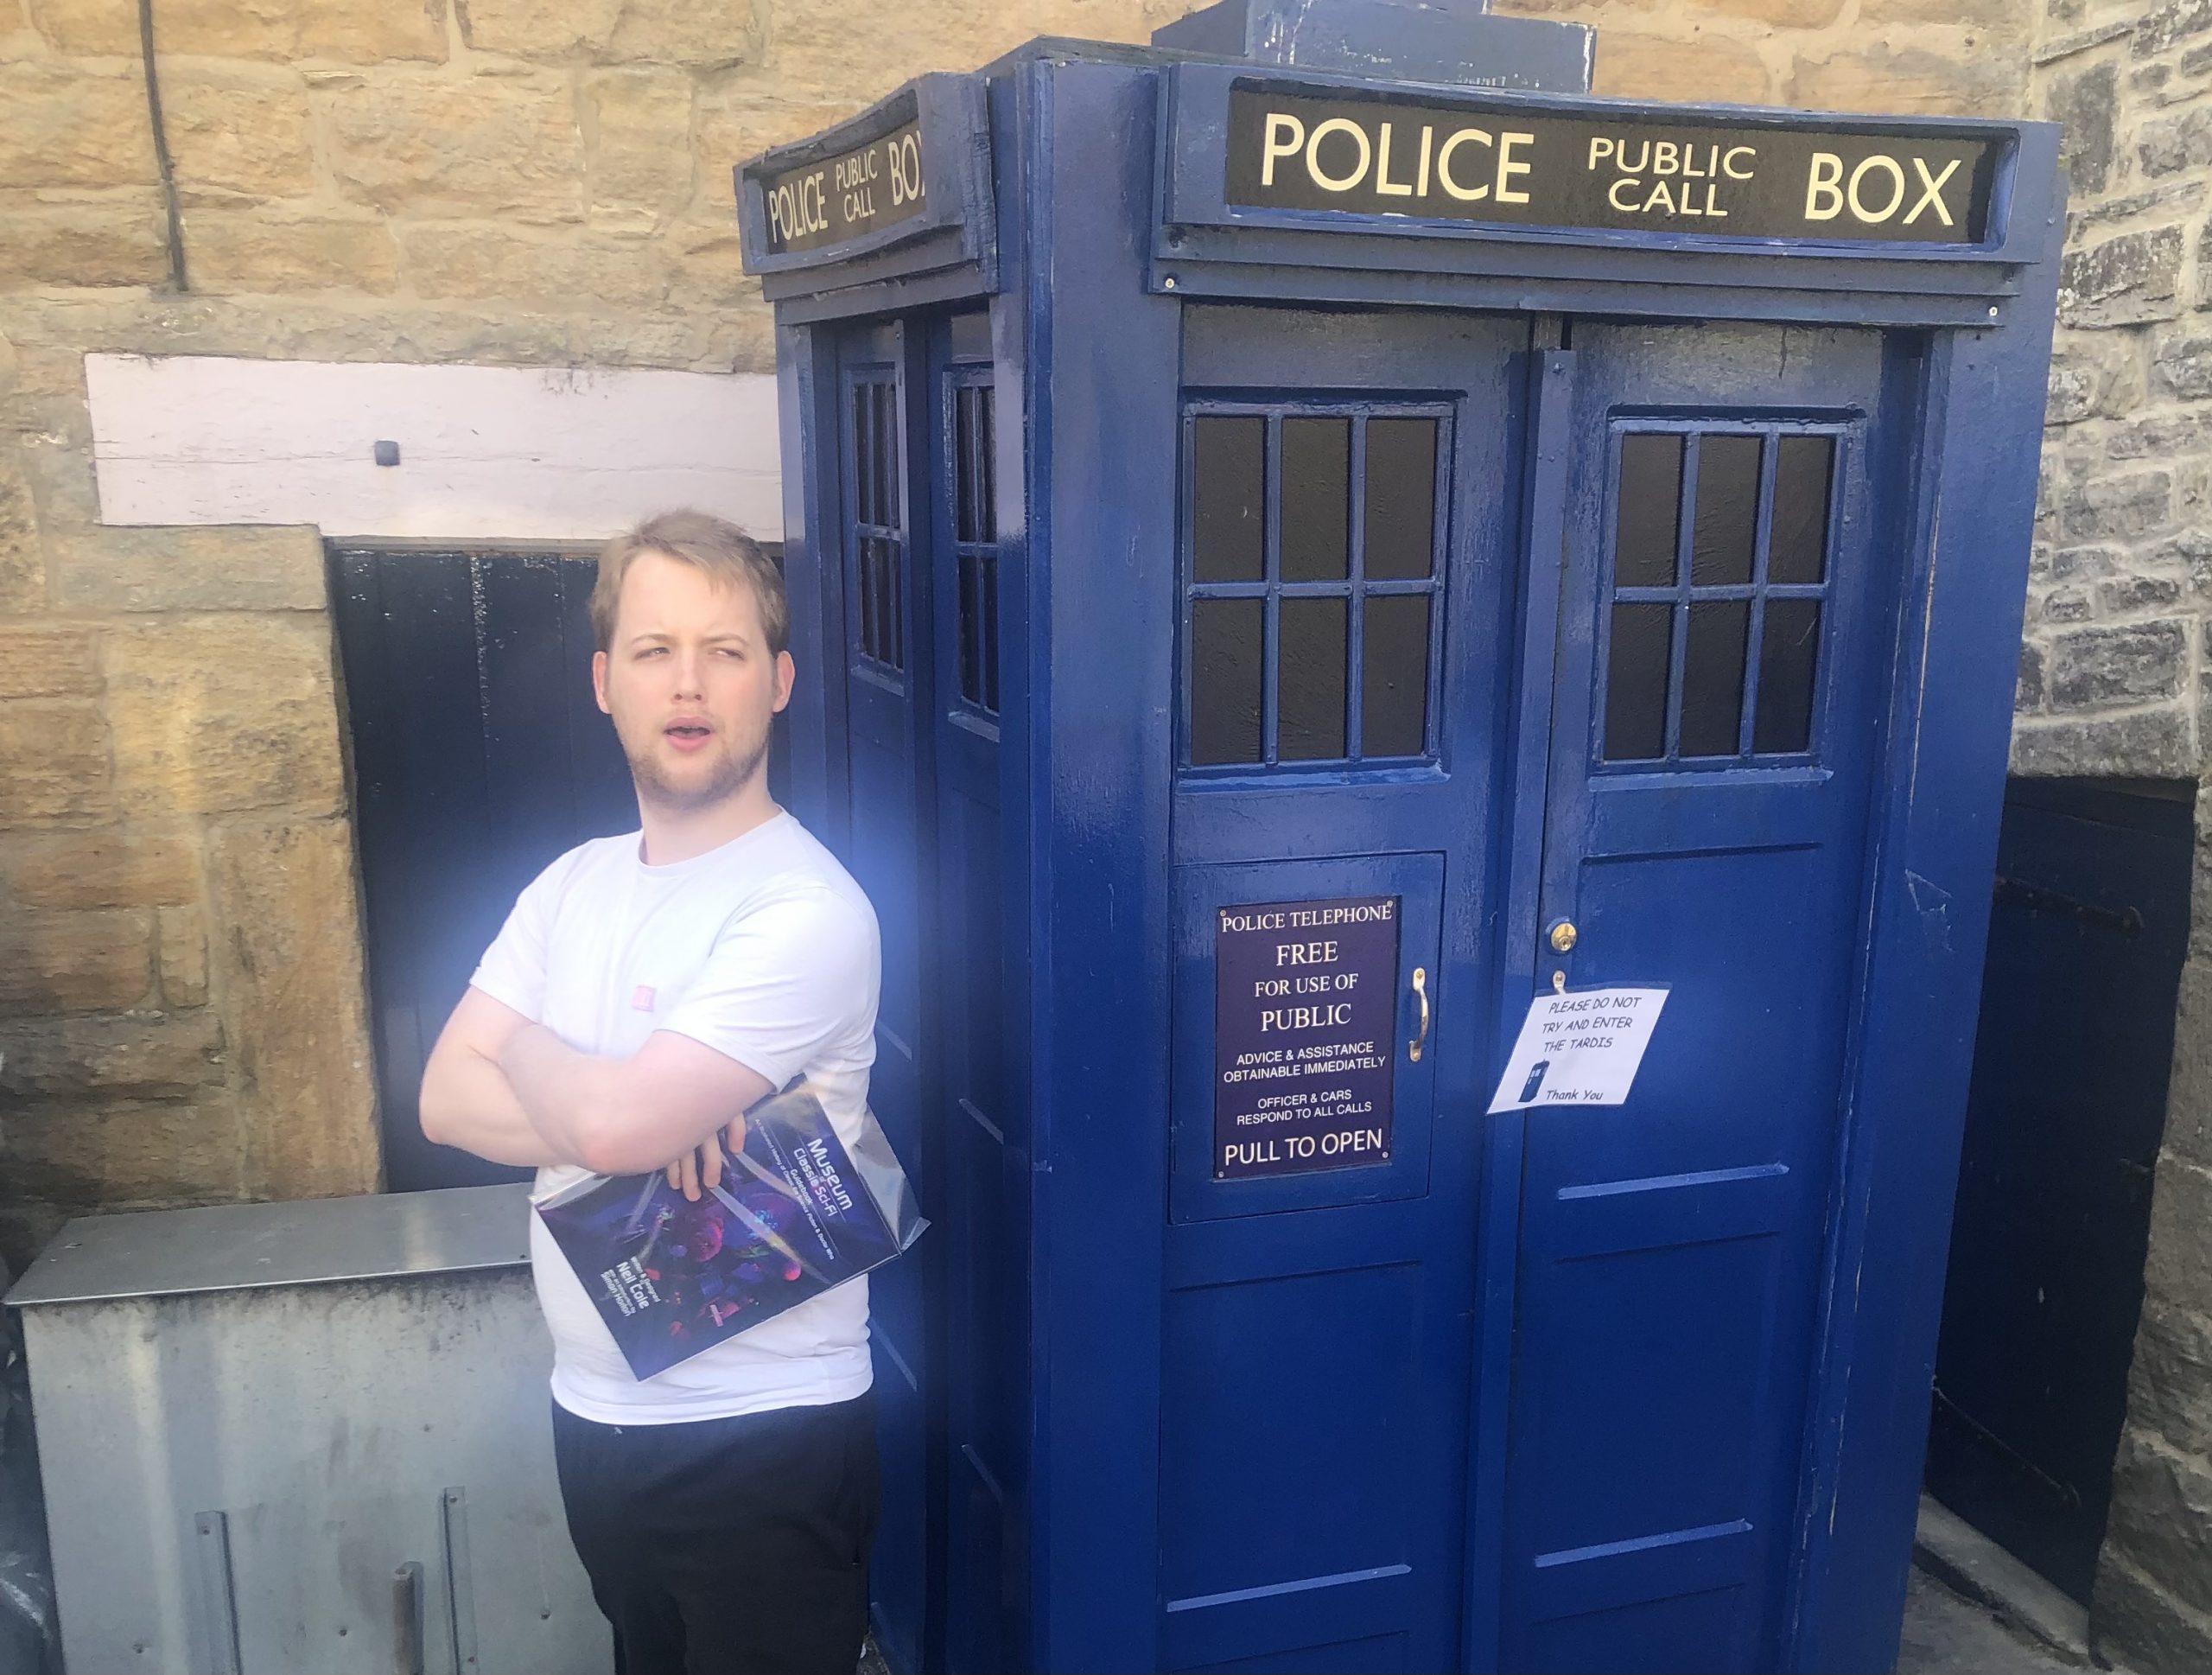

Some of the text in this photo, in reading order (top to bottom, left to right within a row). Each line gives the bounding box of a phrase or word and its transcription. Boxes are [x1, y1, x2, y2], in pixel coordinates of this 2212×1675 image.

[836, 149, 877, 191] PUBLIC
[1262, 113, 1534, 203] POLICE
[1588, 137, 1757, 180] PUBLIC
[1609, 178, 1729, 217] CALL
[1806, 152, 1961, 226] BOX
[769, 172, 828, 243] POLICE
[844, 188, 875, 222] CALL
[1222, 905, 1392, 933] POLICE TELEPHONE
[1276, 941, 1338, 966] FREE
[1255, 973, 1358, 997] FOR USE OF
[1262, 1003, 1351, 1031] PUBLIC
[1548, 997, 1642, 1014] PLEASE DO NOT
[1542, 1017, 1632, 1034] TRY AND ENTER
[1236, 1041, 1374, 1065] ADVICE & ASSISTANCE
[1544, 1037, 1613, 1052] THE TARDIS
[1224, 1056, 1386, 1082] OBTAINABLE IMMEDIATELY
[1258, 1090, 1351, 1109] OFFICER & CARS
[1547, 1089, 1603, 1100] Thank You
[1237, 1102, 1372, 1125] RESPOND TO ALL CALLS
[1225, 1129, 1382, 1165] PULL TO OPEN
[791, 1169, 813, 1205] Guidebook
[794, 1148, 837, 1216] Classic Sci-Fi
[807, 1138, 852, 1210] Museum
[630, 1283, 649, 1309] Cole
